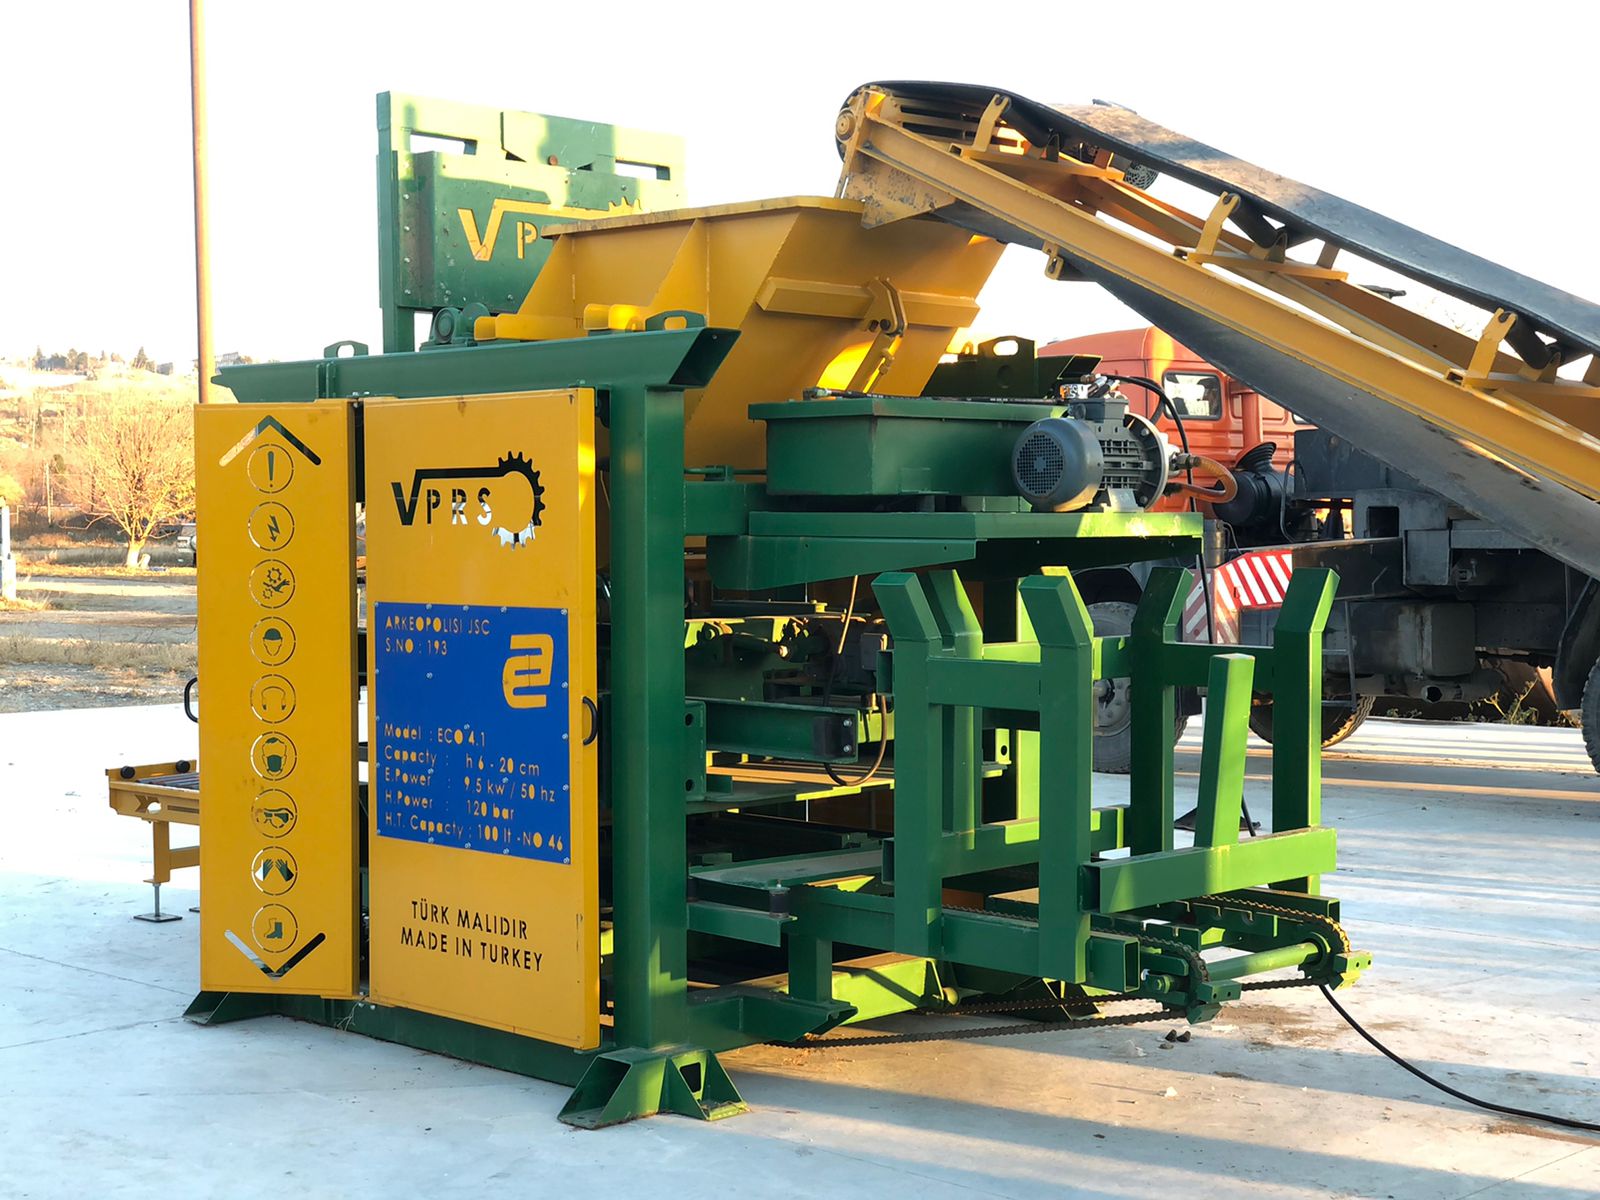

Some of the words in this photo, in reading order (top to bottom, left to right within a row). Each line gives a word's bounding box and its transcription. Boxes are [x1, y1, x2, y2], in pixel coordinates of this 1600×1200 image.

[385, 615, 462, 634] ARKEOPOLISI
[468, 618, 490, 635] JSC
[427, 639, 448, 656] 193
[384, 722, 422, 740] Model
[437, 727, 464, 745] ECO
[468, 730, 485, 748] 4.1
[465, 752, 473, 769] h
[478, 755, 485, 771] 6
[499, 756, 514, 774] 20
[519, 763, 540, 777] cm
[385, 767, 431, 786] E.Power
[487, 778, 505, 796] kw
[521, 783, 535, 800] 50
[541, 785, 555, 802] hz
[385, 789, 433, 808] H.Power
[467, 799, 488, 817] 120
[493, 803, 514, 820] bar
[478, 824, 499, 842] 100
[548, 834, 563, 852] 46
[411, 898, 449, 925] TÜRK
[456, 908, 528, 940] MALIDIR
[400, 926, 448, 953] MADE
[455, 936, 472, 958] IN
[480, 941, 543, 972] TURKEY
